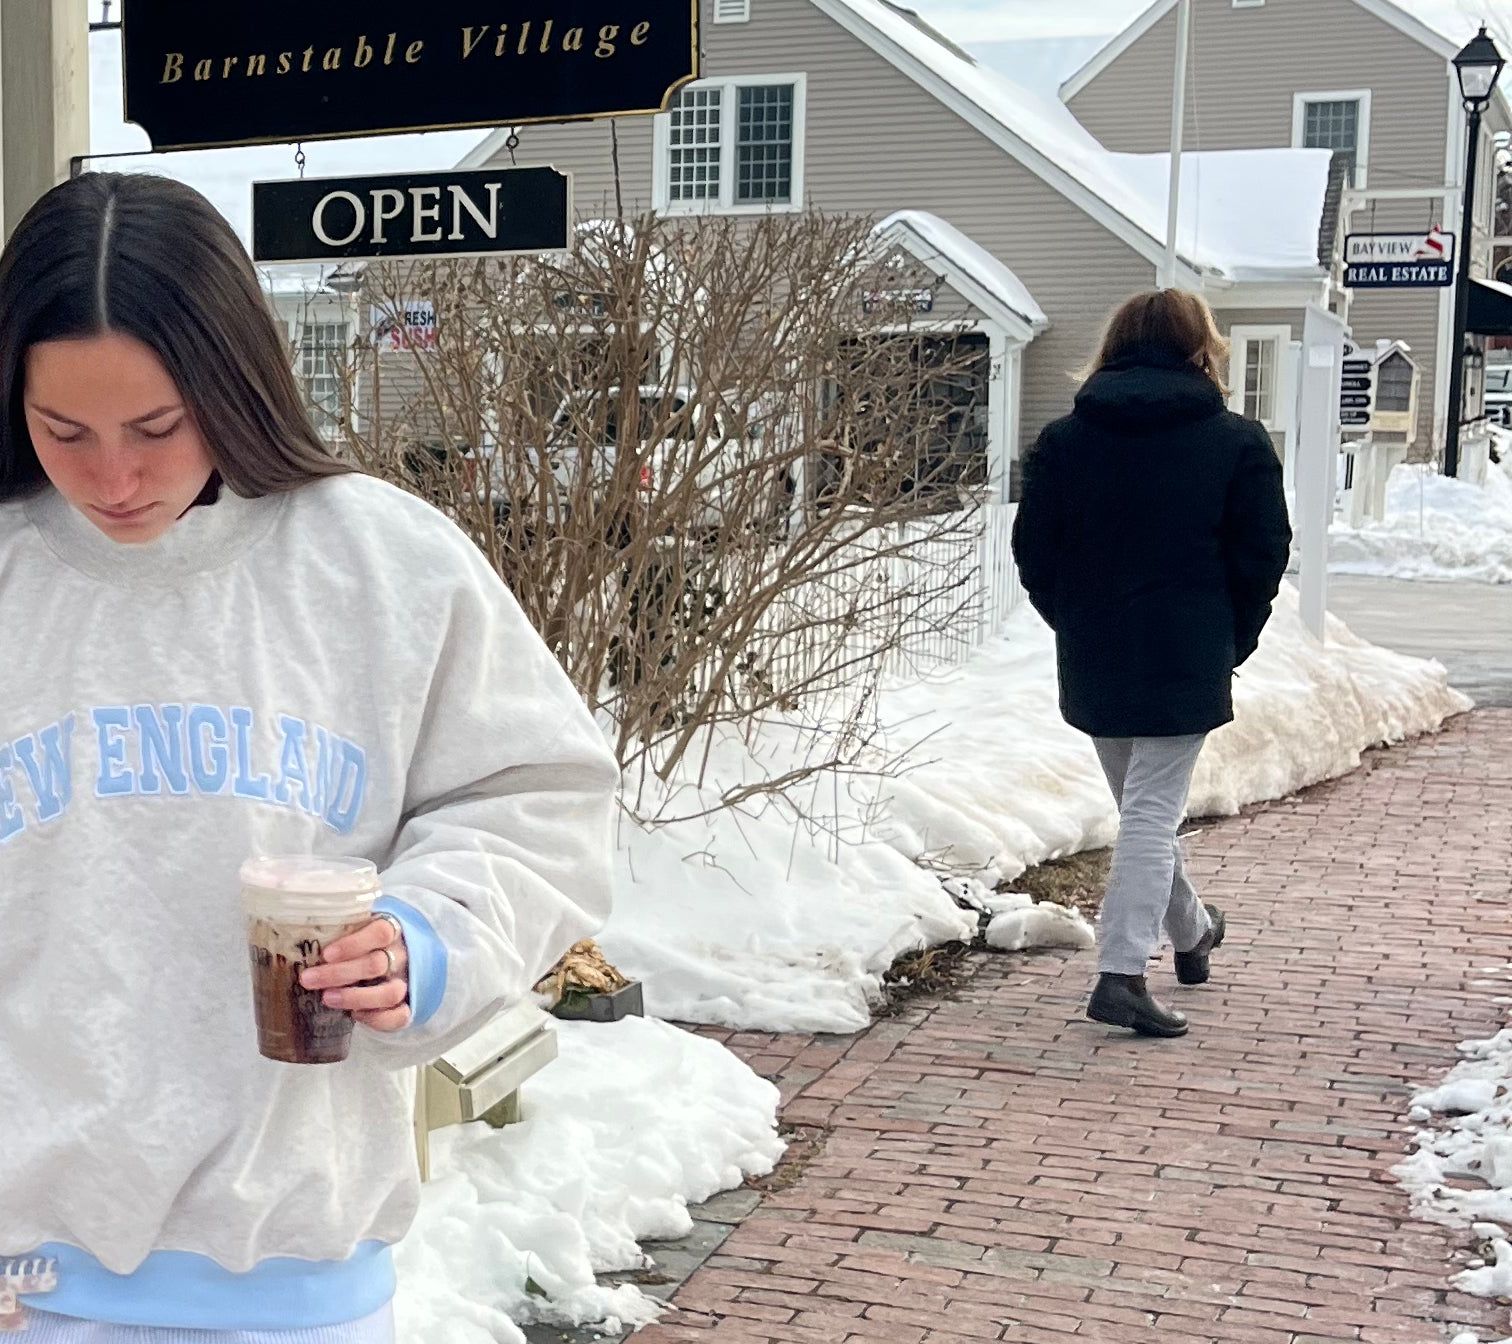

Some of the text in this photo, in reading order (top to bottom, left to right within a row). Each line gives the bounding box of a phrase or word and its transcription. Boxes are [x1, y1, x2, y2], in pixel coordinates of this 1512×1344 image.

[159, 19, 651, 84] Barnstable Village
[312, 183, 502, 247] OPEN
[1348, 265, 1448, 282] REAL ESTATE
[401, 311, 436, 326] RESH
[90, 703, 367, 836] ENGLAND
